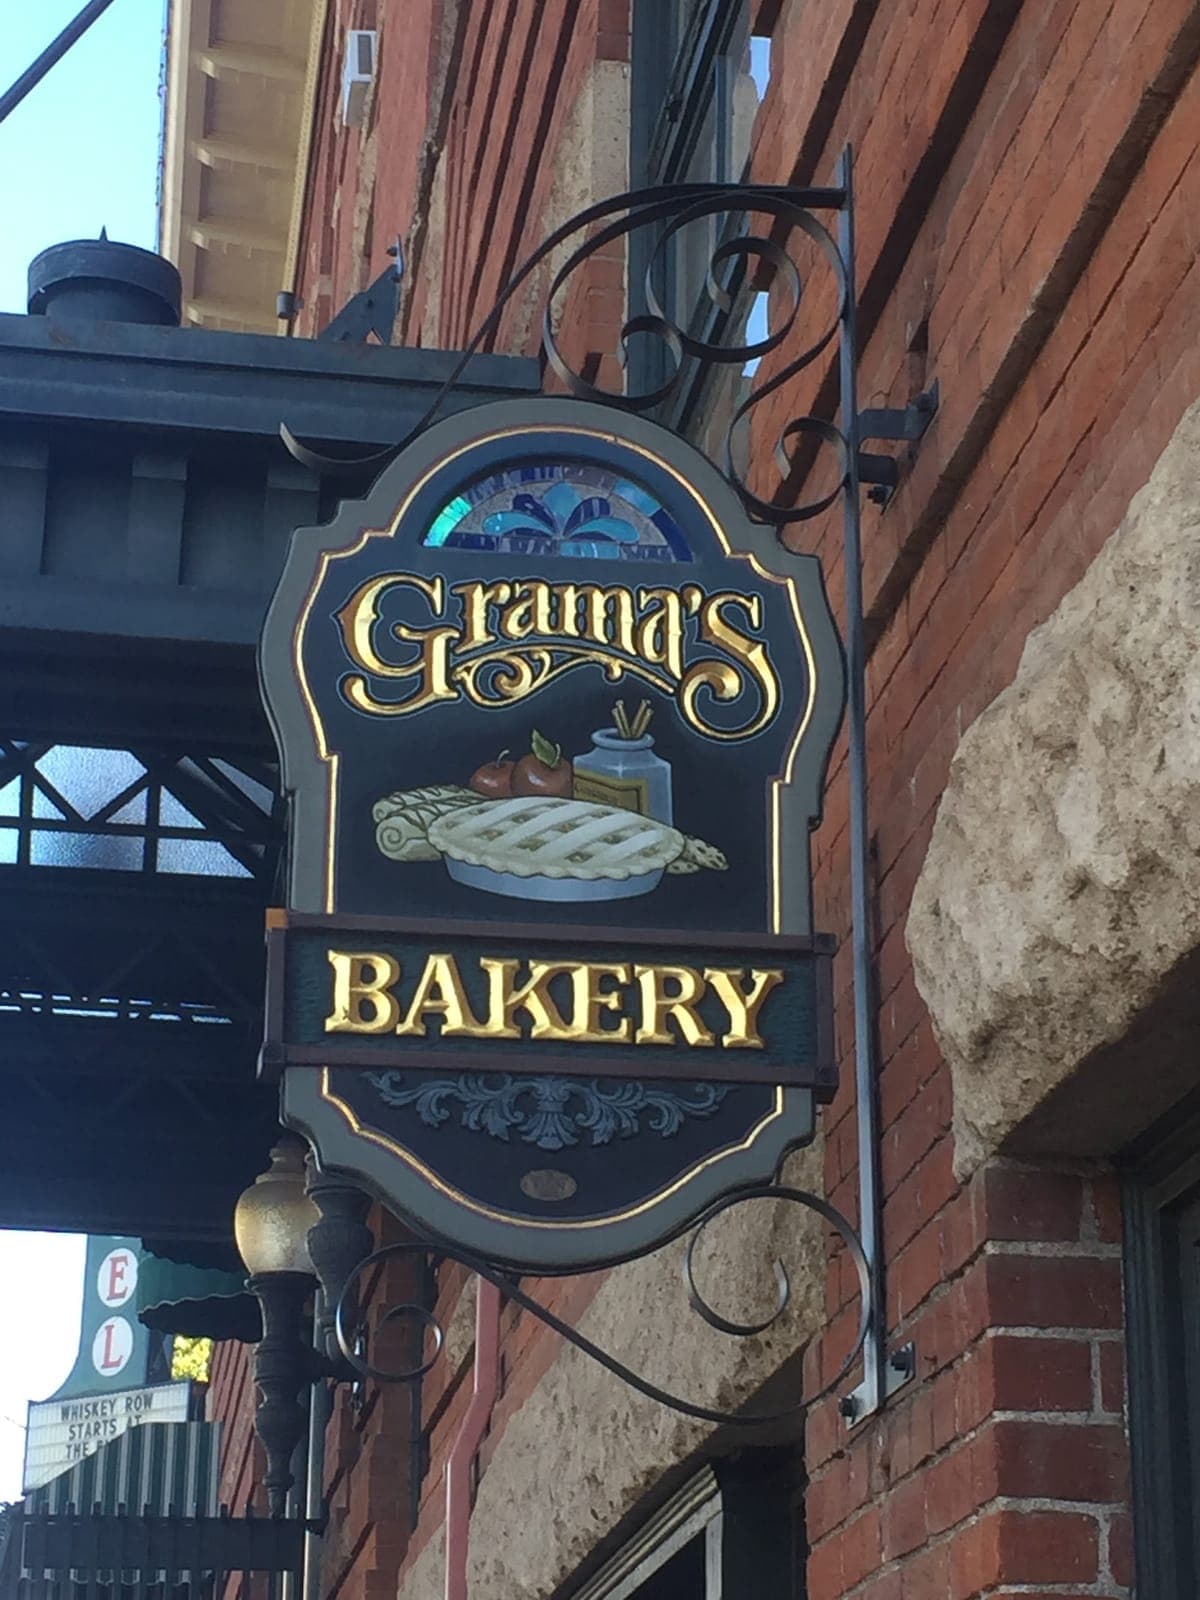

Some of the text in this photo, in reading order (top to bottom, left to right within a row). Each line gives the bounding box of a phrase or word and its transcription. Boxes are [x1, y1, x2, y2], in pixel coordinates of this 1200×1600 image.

[324, 949, 784, 1048] BAKERY
[61, 1393, 154, 1421] WHISKEY ROW
[68, 1414, 142, 1441] STARTS AT
[66, 1441, 89, 1459] THE
